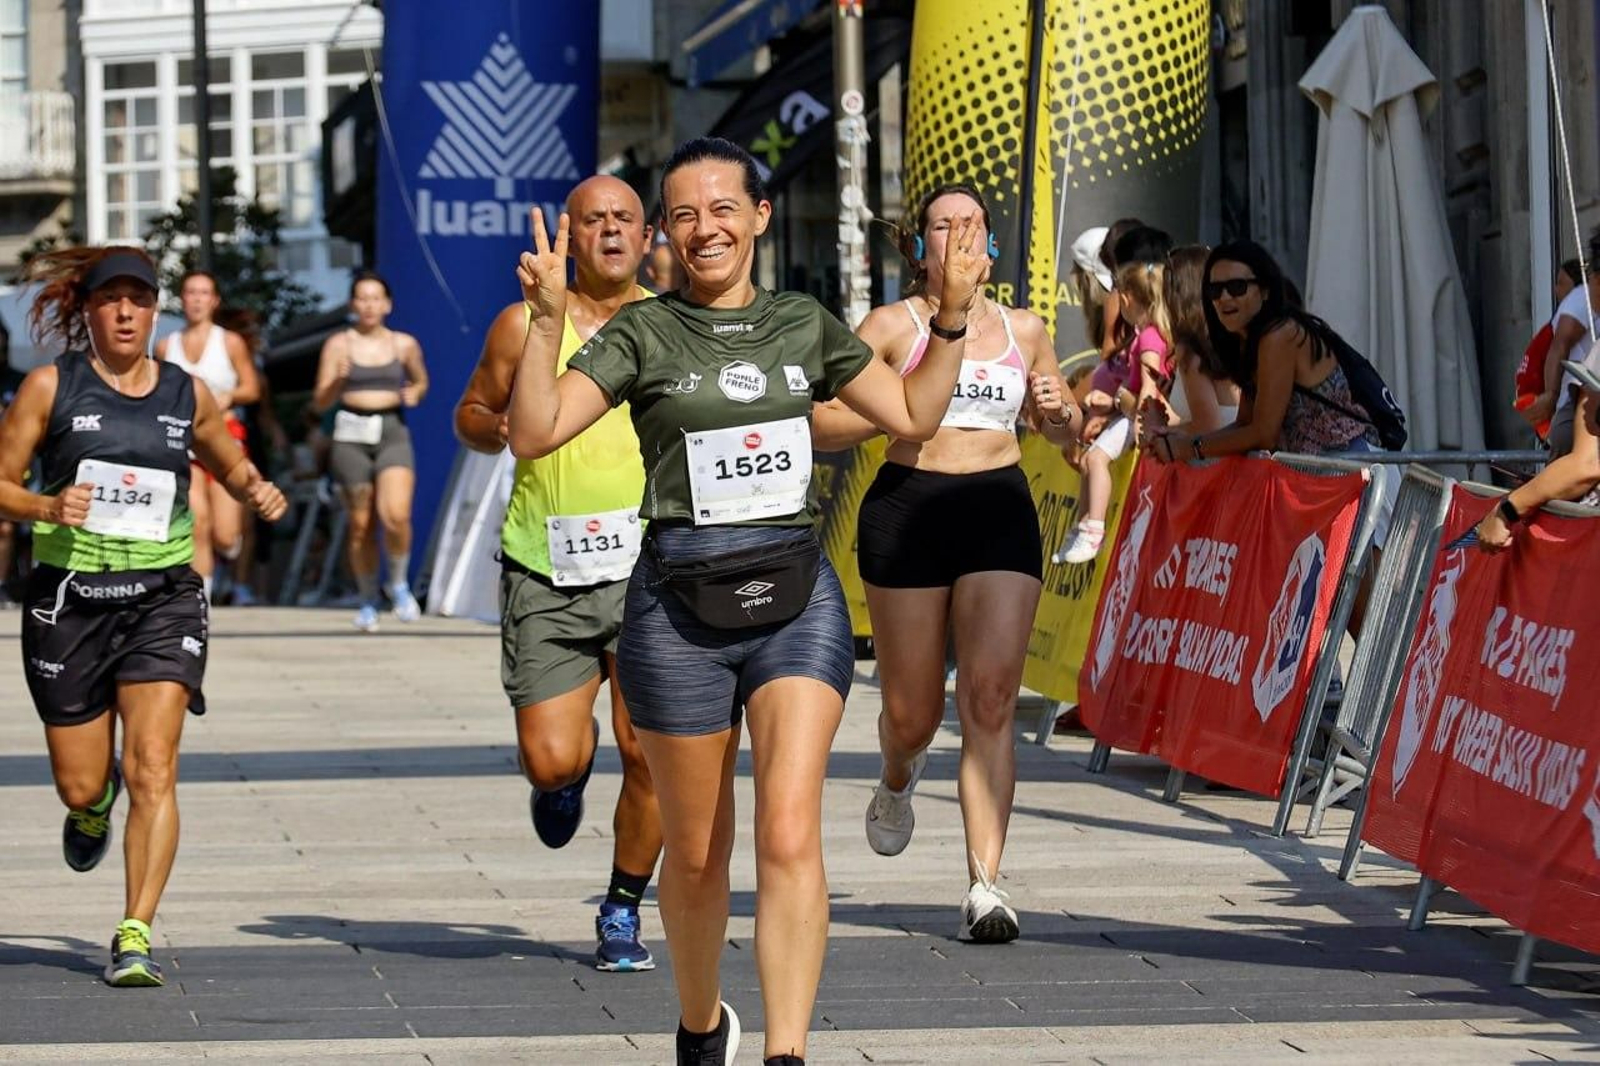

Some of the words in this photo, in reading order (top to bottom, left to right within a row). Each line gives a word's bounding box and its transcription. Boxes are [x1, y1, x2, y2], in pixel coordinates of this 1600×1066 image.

[713, 323, 743, 333] luanvi
[725, 378, 759, 392] FRENO
[726, 371, 760, 385] PONLE
[953, 383, 1006, 401] 1341
[72, 414, 102, 431] DK
[715, 450, 792, 480] 1523
[93, 486, 152, 507] 1134
[565, 534, 624, 555] 1131
[741, 595, 773, 608] umbro
